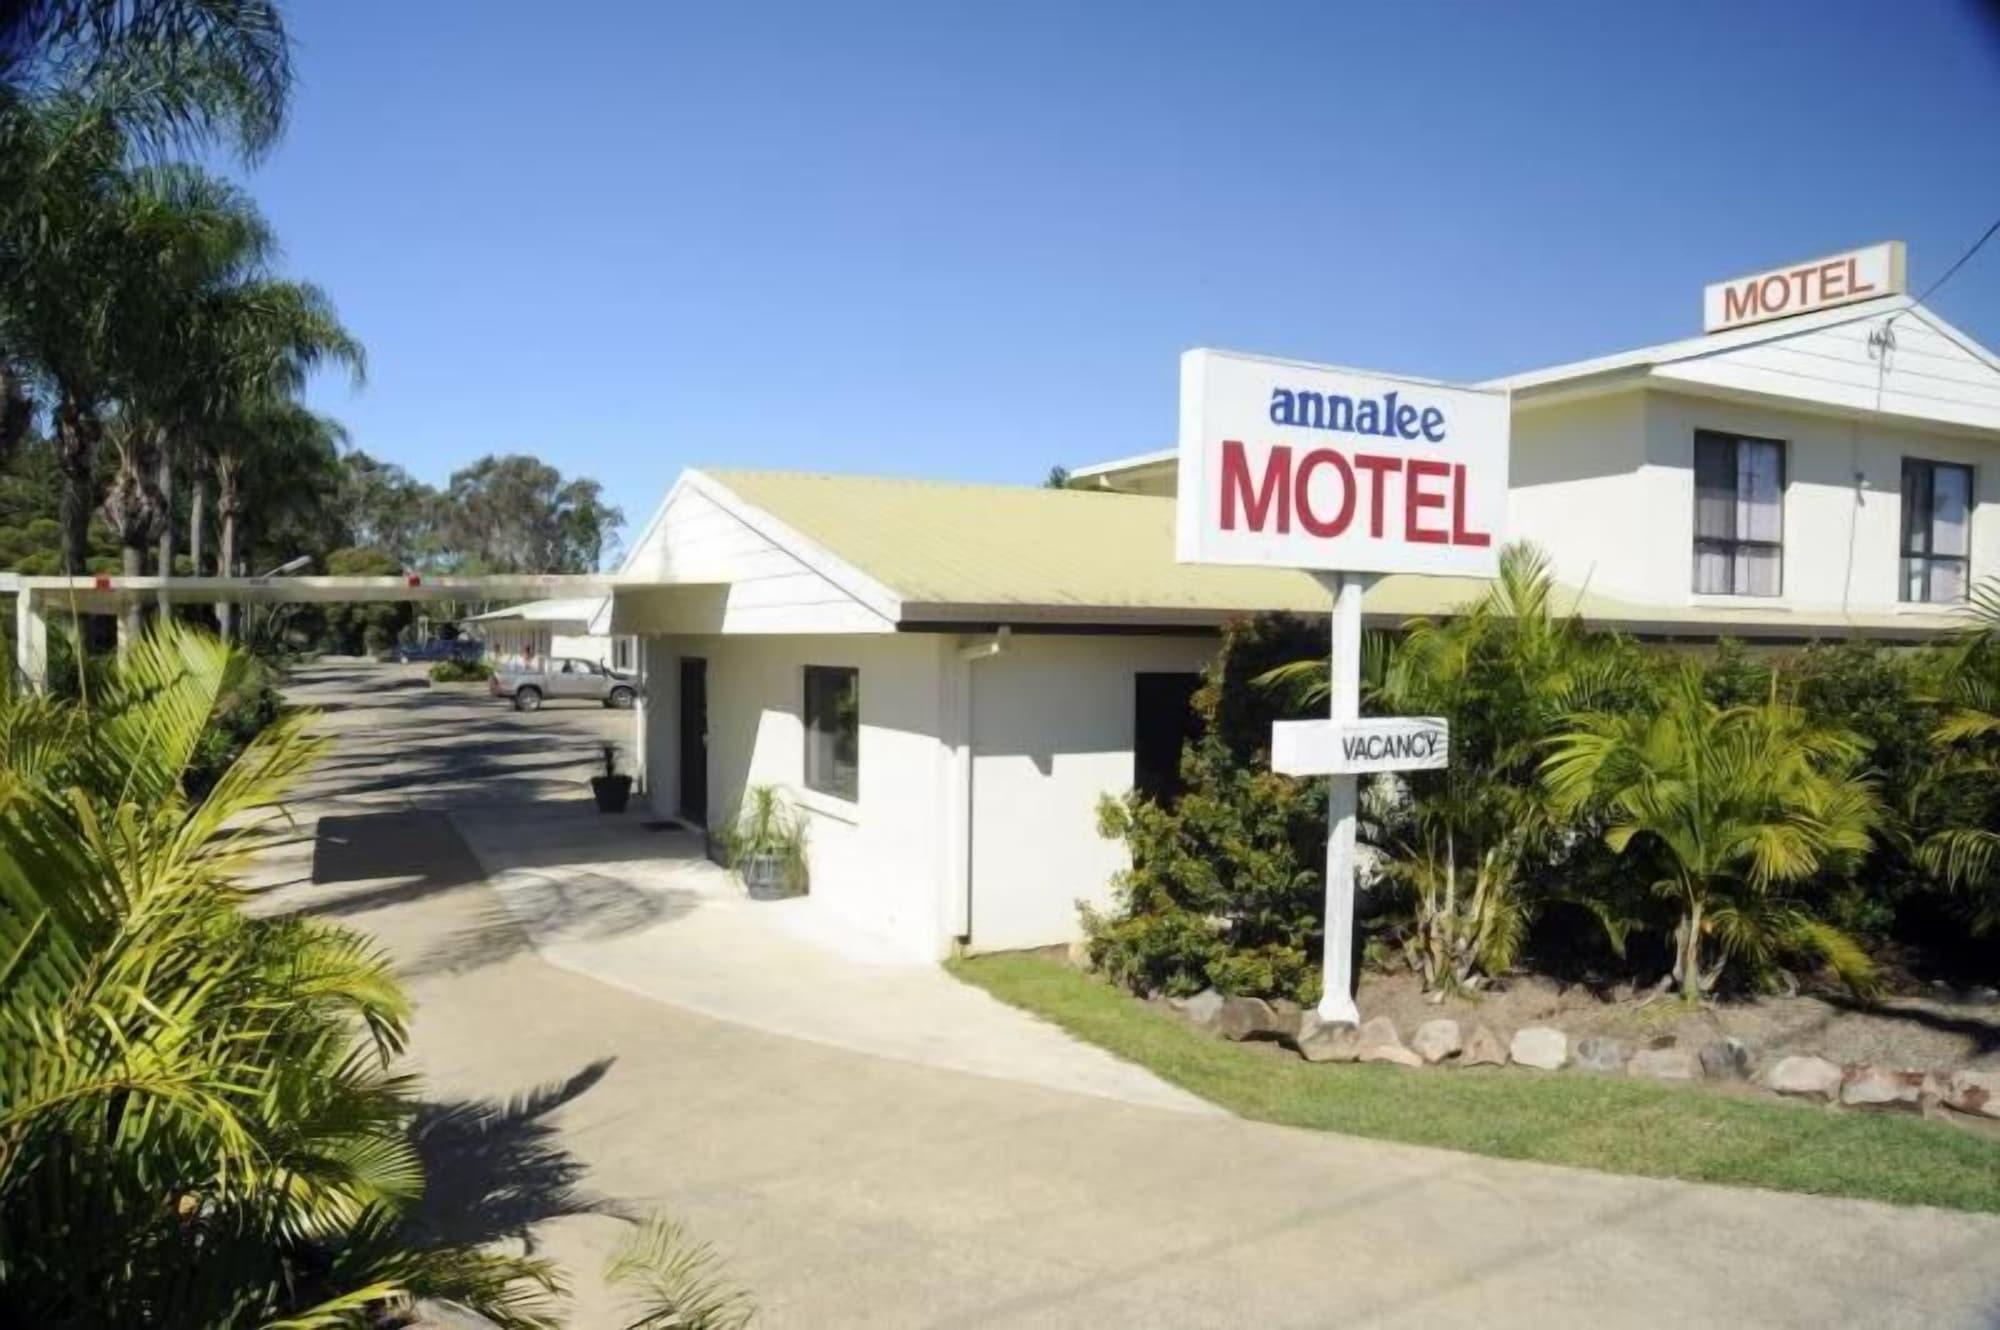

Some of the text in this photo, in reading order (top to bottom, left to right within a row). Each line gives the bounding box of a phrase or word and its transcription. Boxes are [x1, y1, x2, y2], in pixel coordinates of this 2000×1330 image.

[1724, 257, 1875, 322] MOTEL
[1270, 387, 1446, 442] annalee
[1220, 440, 1491, 547] MOTEL
[1342, 732, 1438, 760] VACANCY
